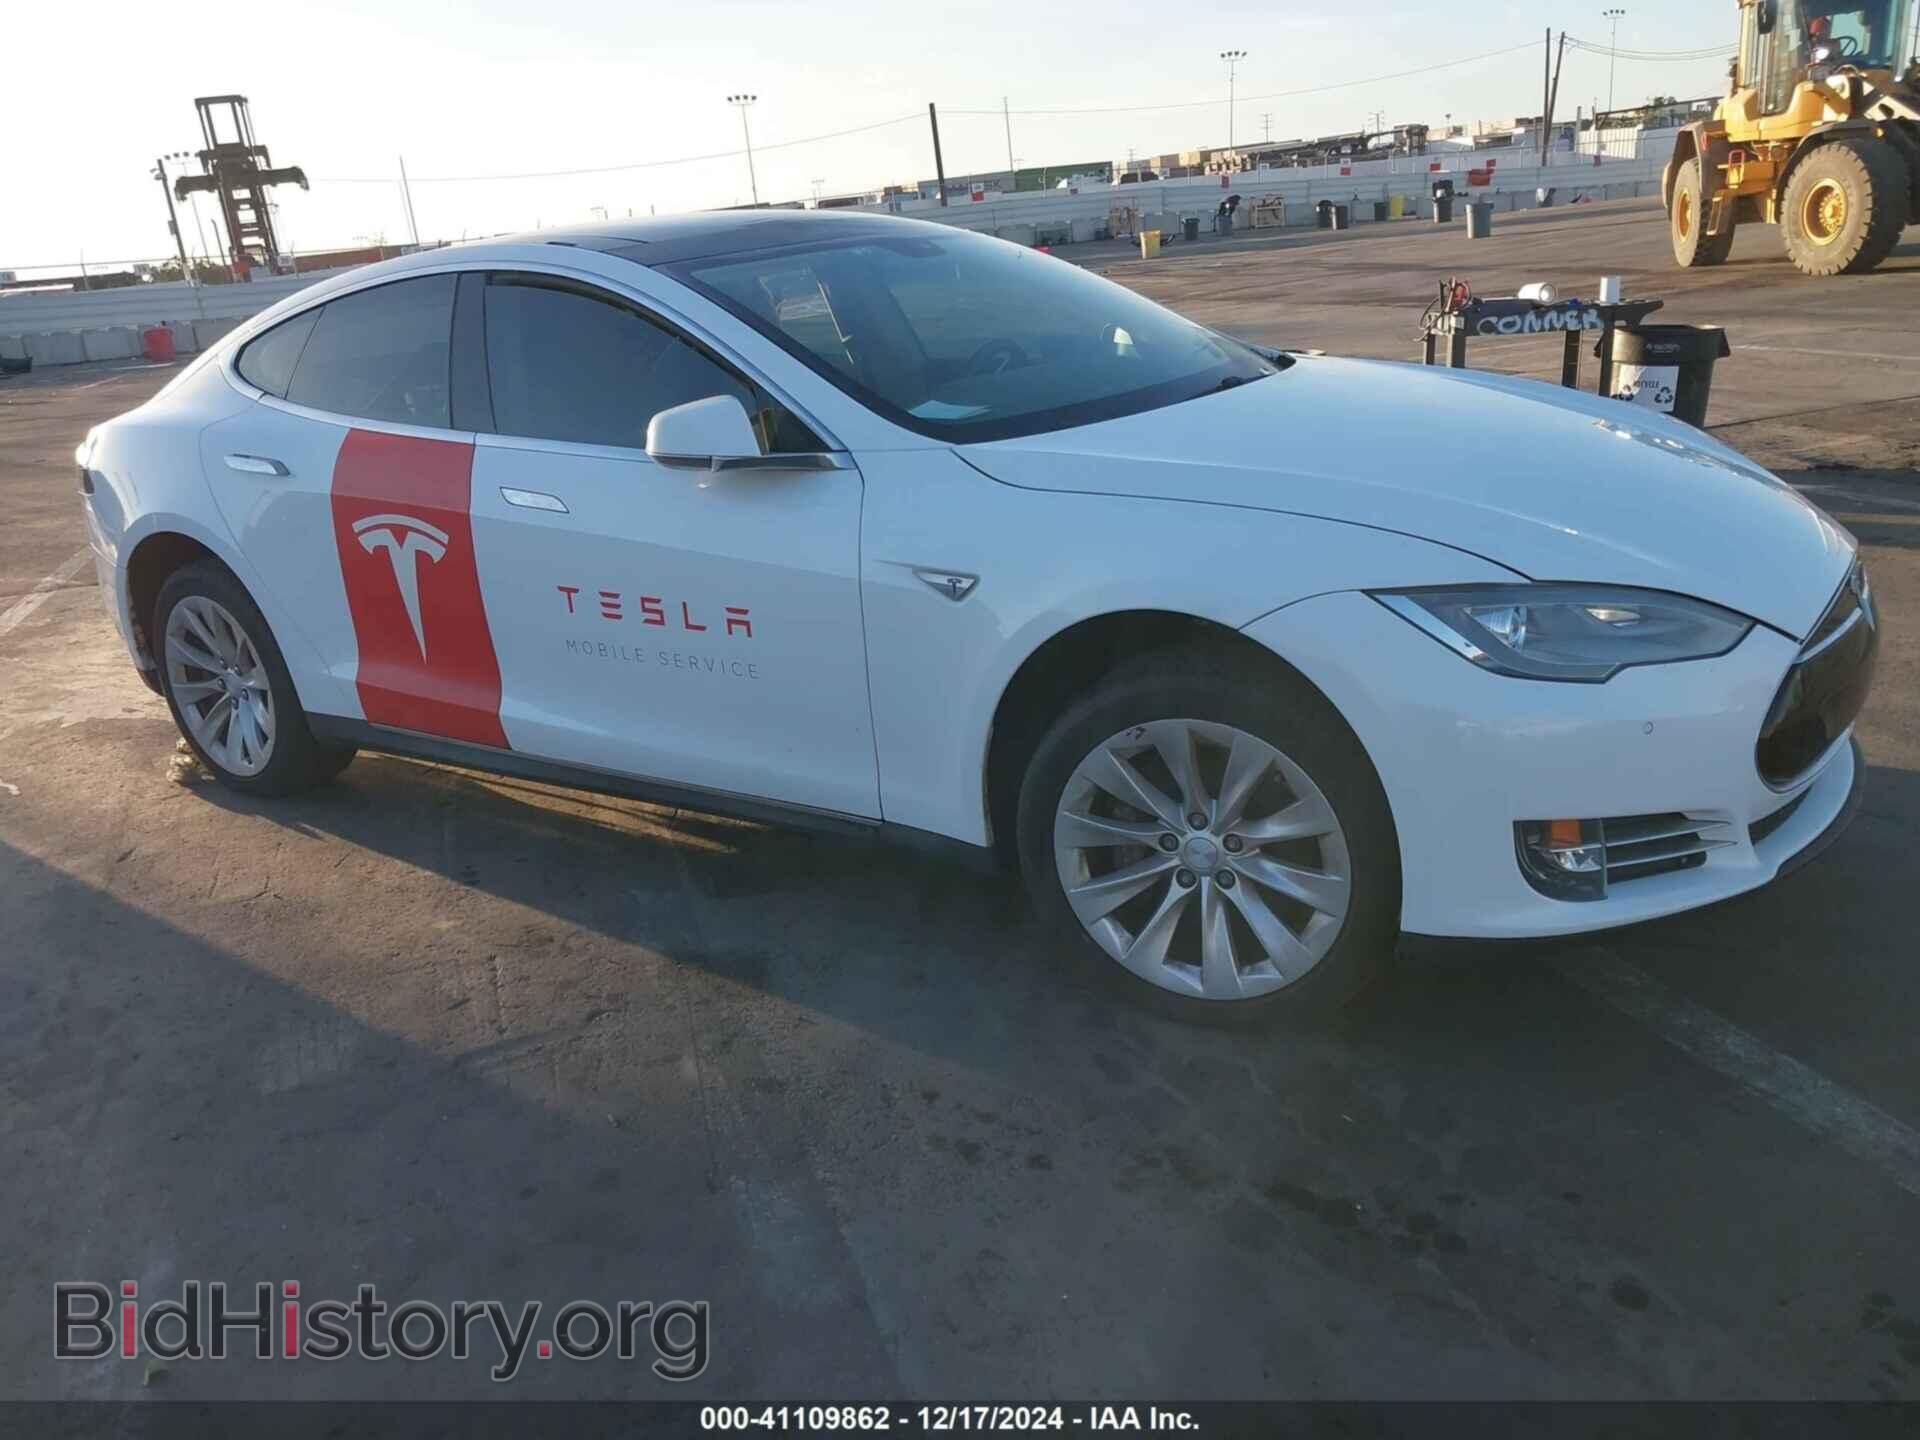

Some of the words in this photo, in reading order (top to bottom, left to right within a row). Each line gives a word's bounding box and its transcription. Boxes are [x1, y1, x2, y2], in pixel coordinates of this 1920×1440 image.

[556, 584, 753, 639] TESLA
[565, 638, 646, 664] MOBILE
[657, 650, 761, 680] SERVICE
